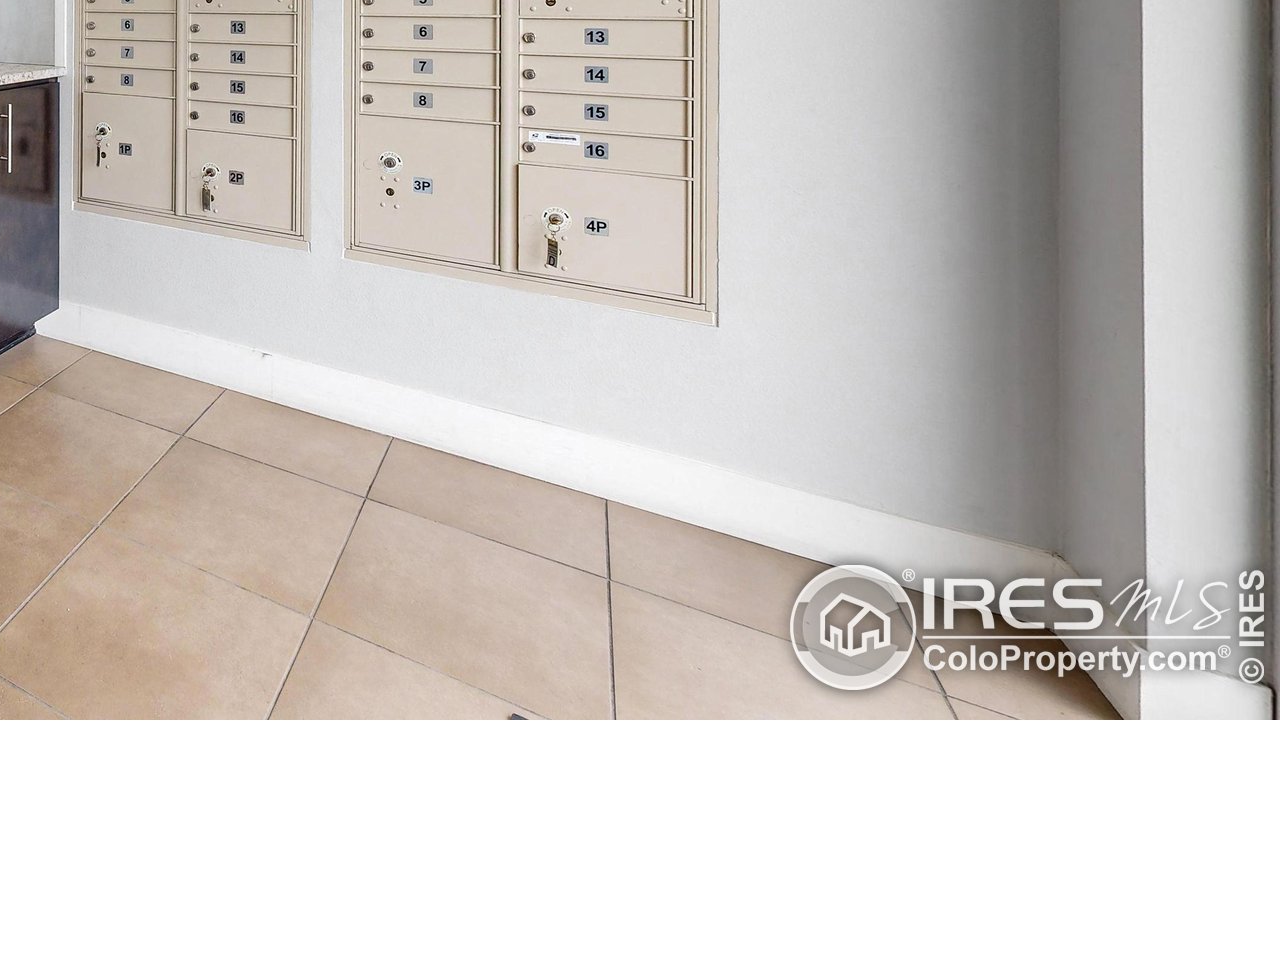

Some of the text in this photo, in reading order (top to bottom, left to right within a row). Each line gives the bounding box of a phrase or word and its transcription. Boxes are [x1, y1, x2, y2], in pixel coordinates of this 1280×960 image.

[124, 20, 131, 29] 6
[231, 22, 244, 33] 13
[419, 26, 427, 37] 6
[586, 30, 605, 43] 13
[125, 48, 130, 57] 7
[231, 52, 244, 62] 14
[418, 61, 427, 71] 7
[124, 75, 130, 85] 8
[586, 68, 606, 81] 14
[231, 82, 244, 93] 15
[418, 95, 427, 106] 8
[231, 112, 244, 123] 16
[586, 106, 606, 119] 15
[119, 144, 131, 154] 1P
[586, 144, 605, 157] 16
[230, 172, 243, 183] 2P
[413, 180, 431, 191] 3P
[586, 220, 607, 233] 4P
